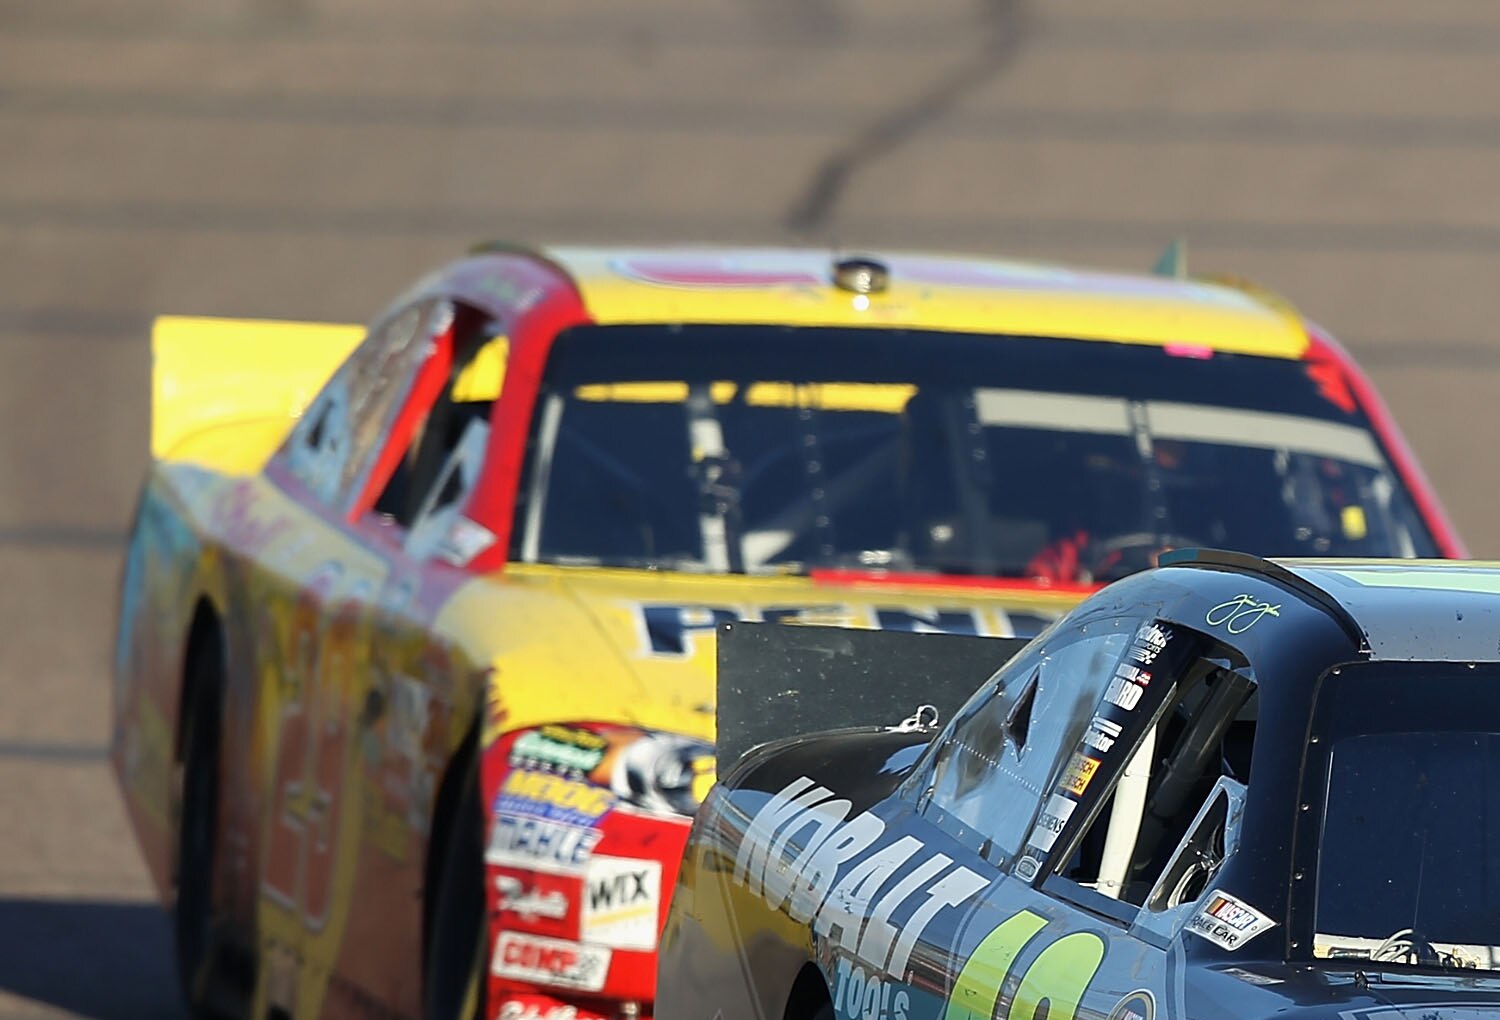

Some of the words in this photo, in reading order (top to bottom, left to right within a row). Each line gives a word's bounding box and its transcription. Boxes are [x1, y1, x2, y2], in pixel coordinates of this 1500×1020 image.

[589, 870, 649, 911] WIX
[732, 776, 991, 981] KOBALT
[1213, 900, 1259, 931] NASCAR
[1212, 925, 1238, 946] CAR
